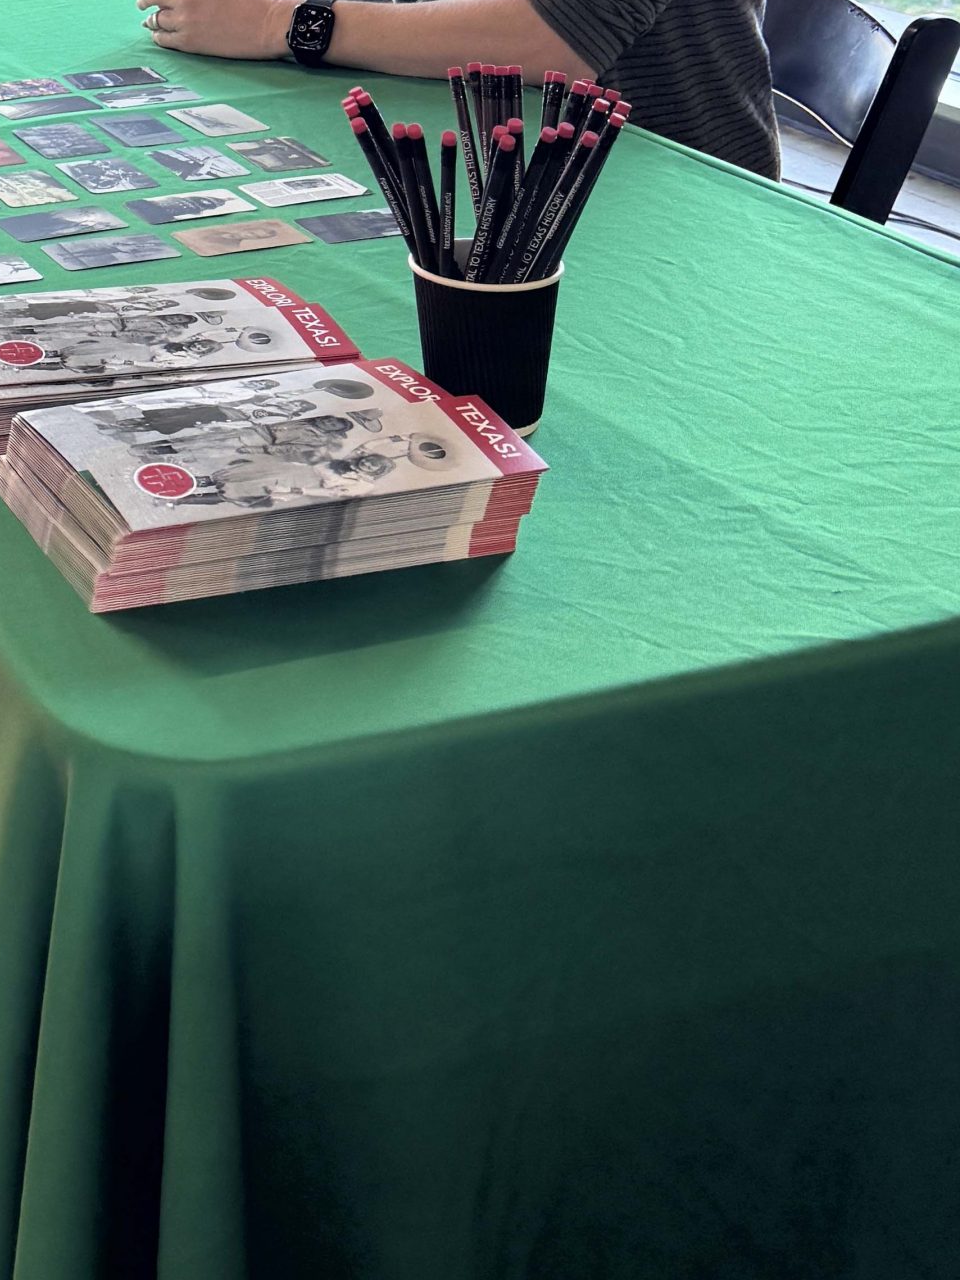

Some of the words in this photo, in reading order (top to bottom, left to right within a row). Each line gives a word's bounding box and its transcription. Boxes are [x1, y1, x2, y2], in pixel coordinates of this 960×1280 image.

[460, 130, 478, 170] HISTORY
[470, 169, 482, 204] TEXAS
[443, 192, 451, 249] texashistory.unt.edu
[481, 197, 497, 231] HISTORY
[529, 229, 547, 253] TEXAS
[541, 192, 565, 231] HISTORY
[475, 230, 488, 256] TEXAS
[466, 265, 478, 283] TAL
[471, 256, 481, 268] TO
[292, 307, 341, 347] TEXAS!
[374, 365, 441, 402] EXPLOR
[455, 402, 522, 461] TEXAS!
